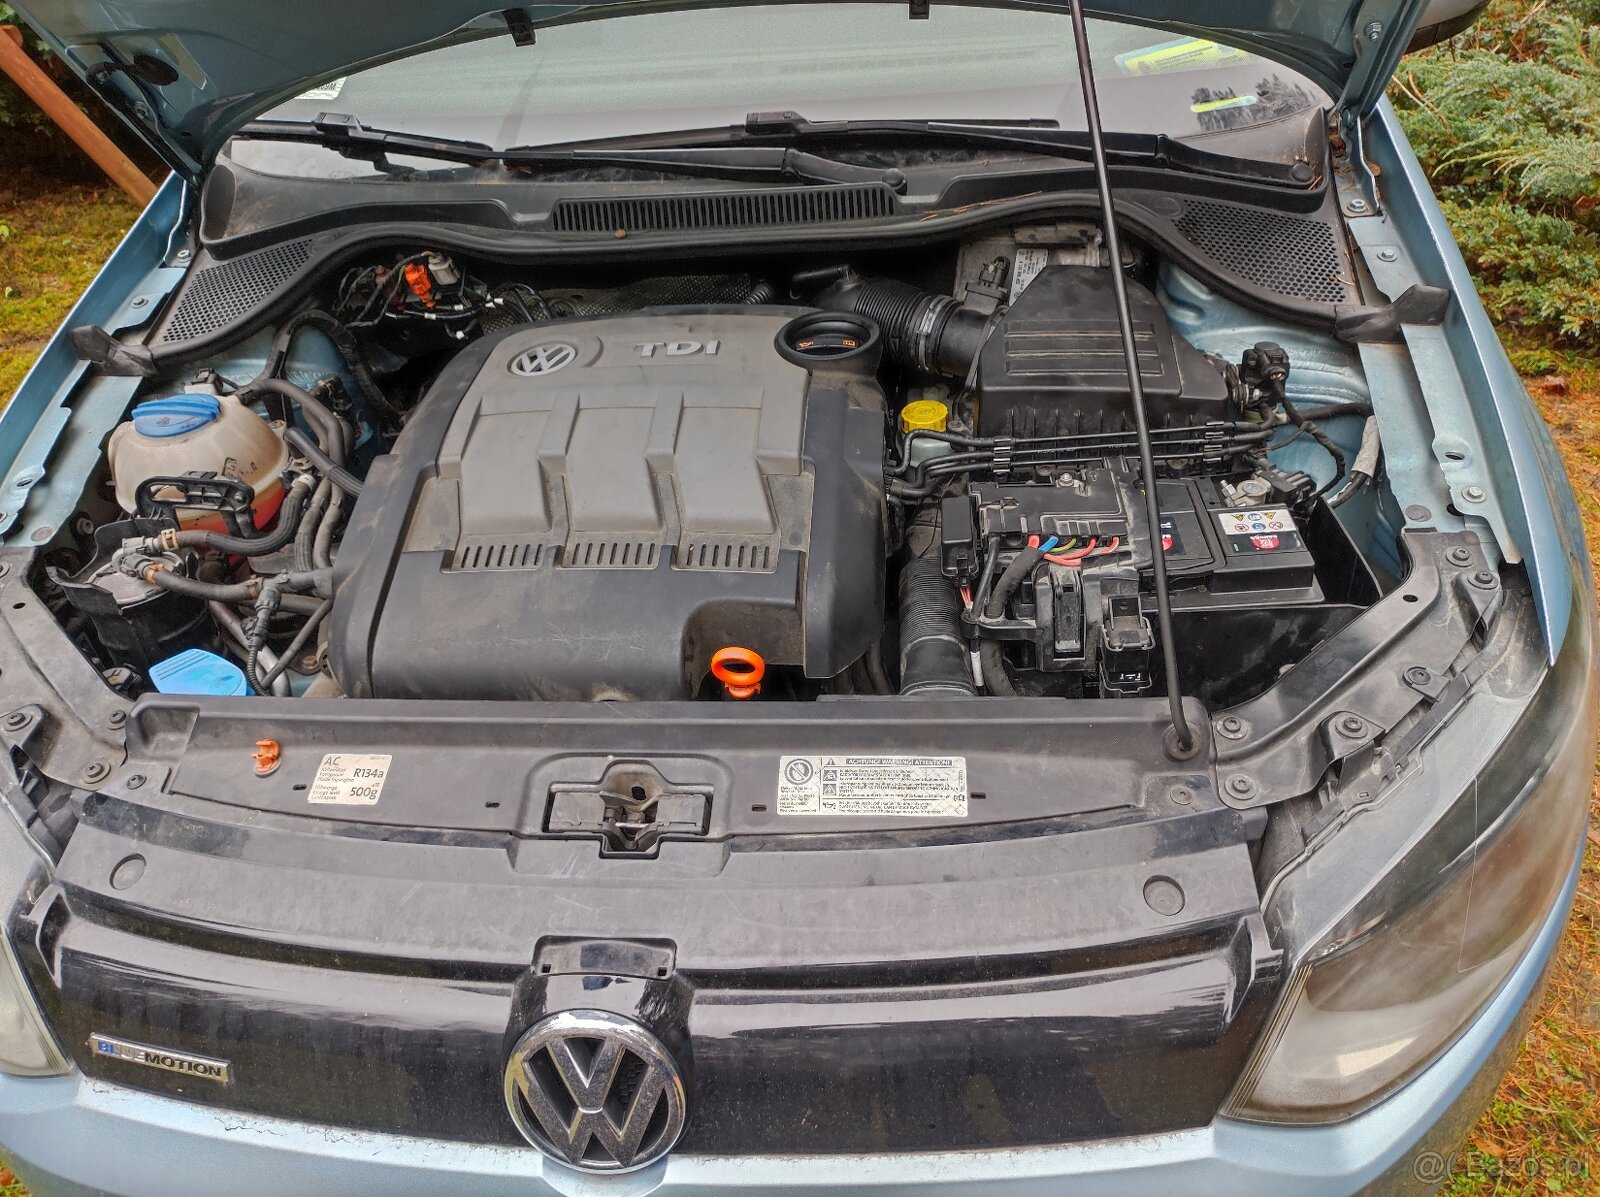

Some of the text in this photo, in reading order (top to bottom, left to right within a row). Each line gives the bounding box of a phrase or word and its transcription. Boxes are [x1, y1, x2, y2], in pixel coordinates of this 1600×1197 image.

[632, 339, 721, 359] TDI
[324, 756, 341, 766] AC
[353, 768, 384, 778] R134a
[350, 787, 378, 799] 500g
